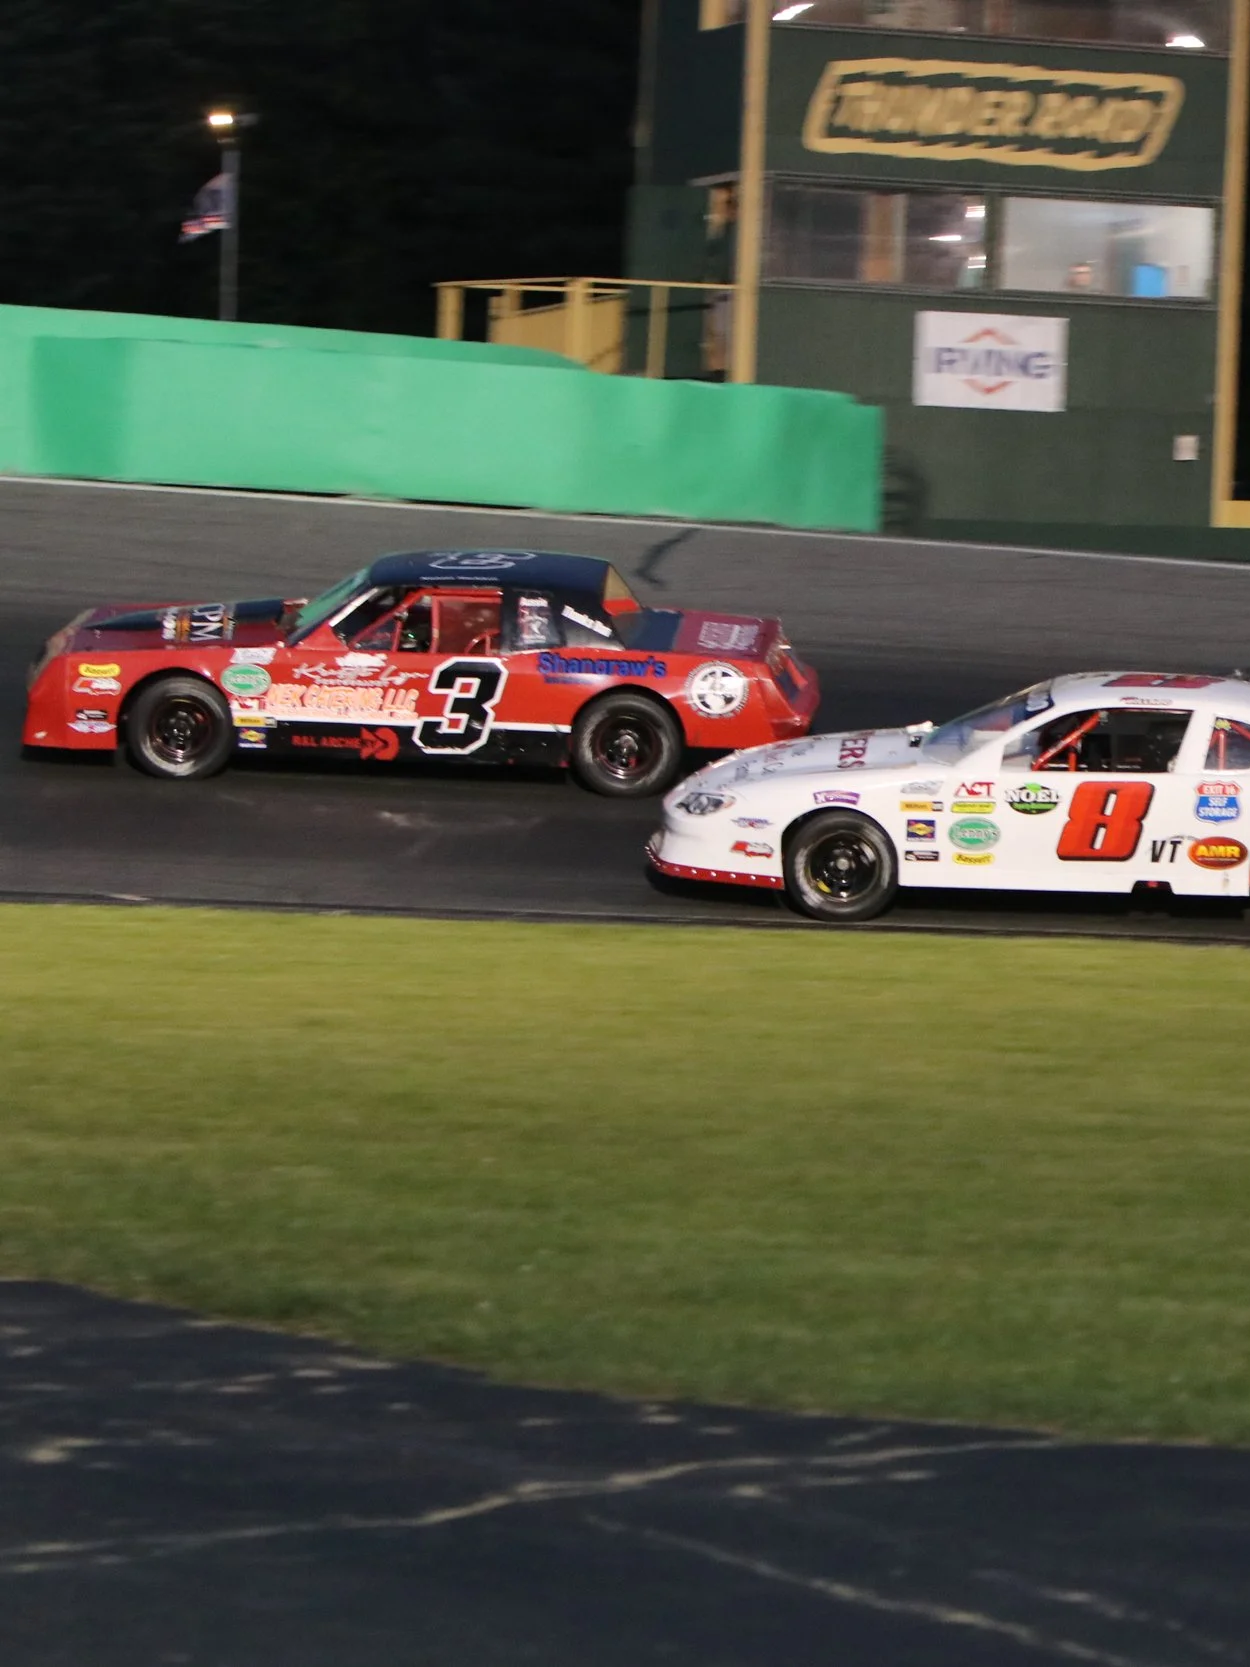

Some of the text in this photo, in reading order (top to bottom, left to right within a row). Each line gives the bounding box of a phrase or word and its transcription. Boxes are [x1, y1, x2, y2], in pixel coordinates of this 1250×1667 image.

[412, 656, 509, 754] 3
[954, 781, 996, 798] ACT
[1203, 784, 1223, 795] EXIT
[1056, 781, 1155, 861] 8
[1151, 839, 1182, 863] VT
[1197, 845, 1241, 858] AMR
